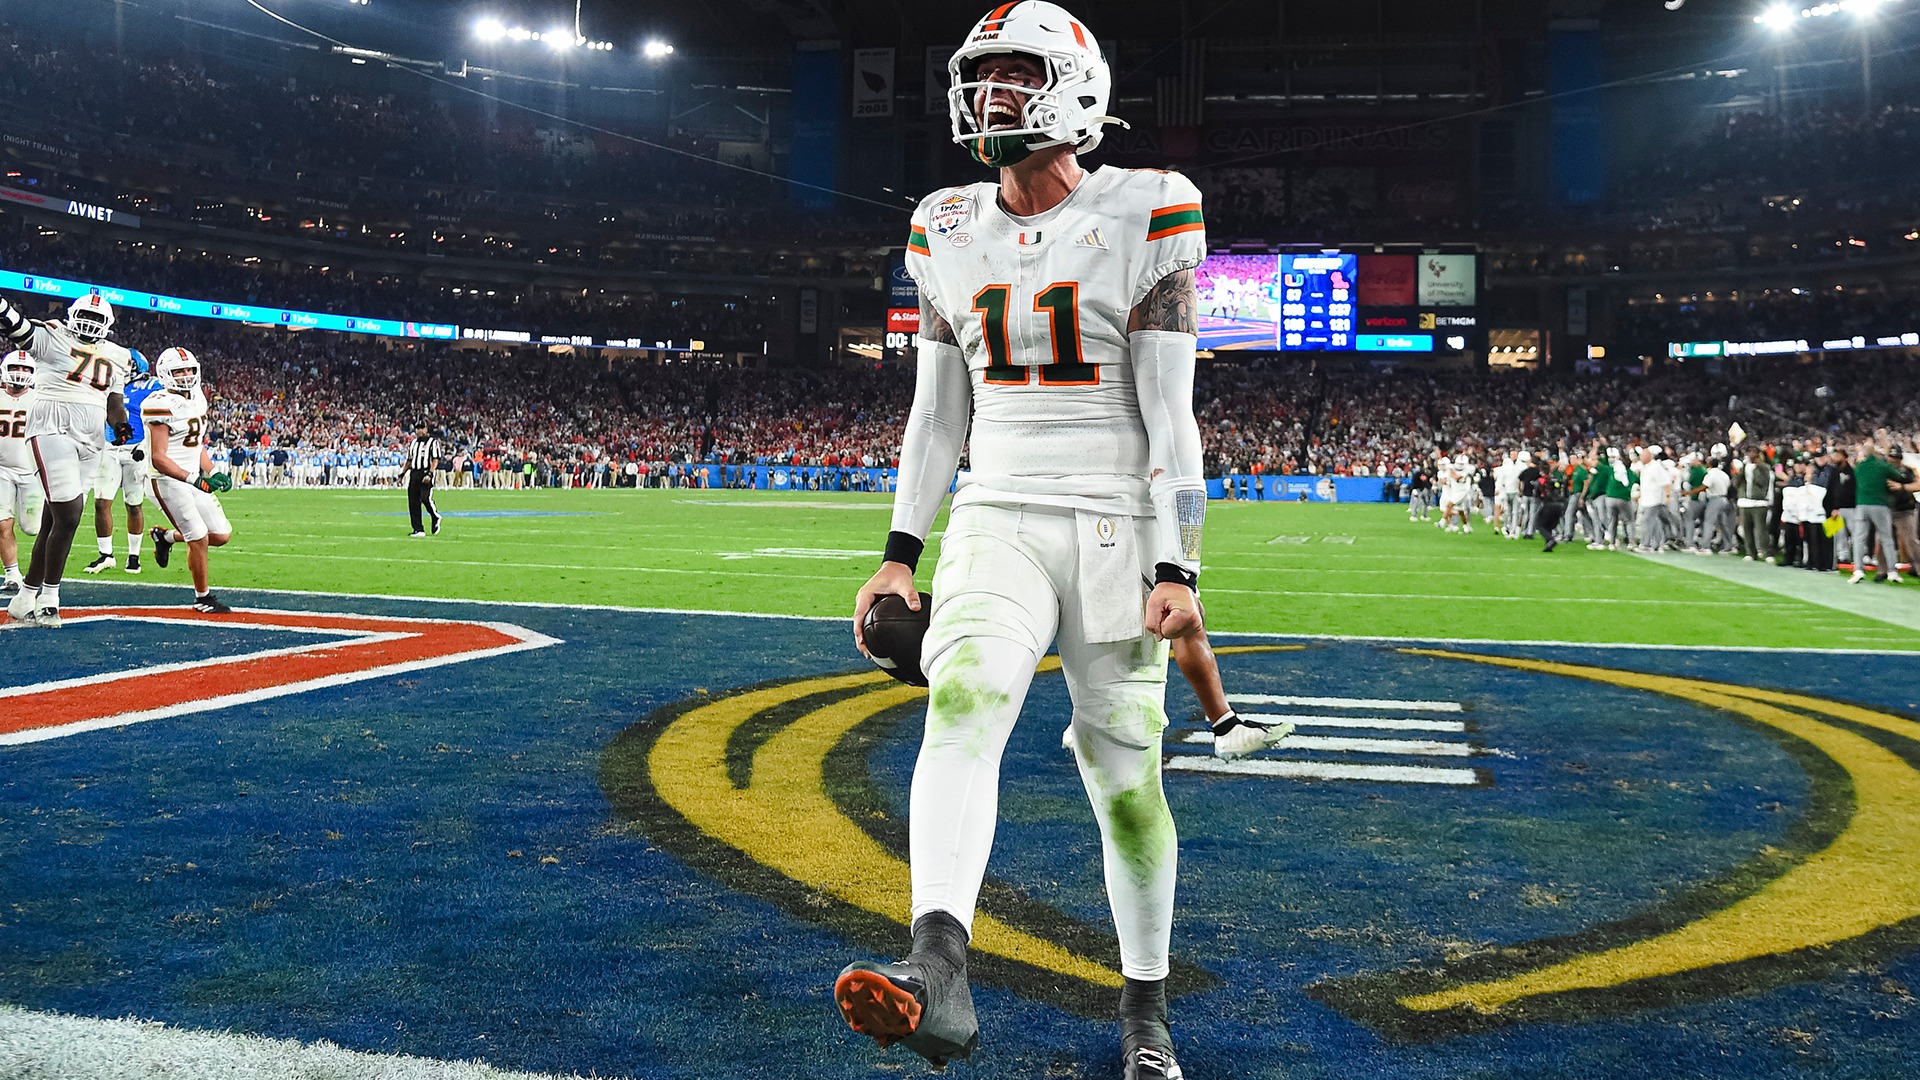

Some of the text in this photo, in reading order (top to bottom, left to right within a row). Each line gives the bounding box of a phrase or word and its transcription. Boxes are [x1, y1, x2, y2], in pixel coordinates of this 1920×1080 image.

[972, 33, 999, 43] MIAMI
[1210, 126, 1449, 153] CARDINALS
[68, 201, 114, 222] AVNET
[35, 279, 61, 292] Vrbo
[159, 299, 181, 310] Vrbo
[223, 306, 251, 318] Vrbo
[902, 312, 920, 321] State
[292, 314, 318, 325] Vrbo
[1366, 317, 1408, 326] verizon
[1435, 317, 1476, 326] BETMGM
[357, 320, 381, 331] Vrbo
[971, 281, 1100, 386] 11
[66, 347, 113, 391] 70
